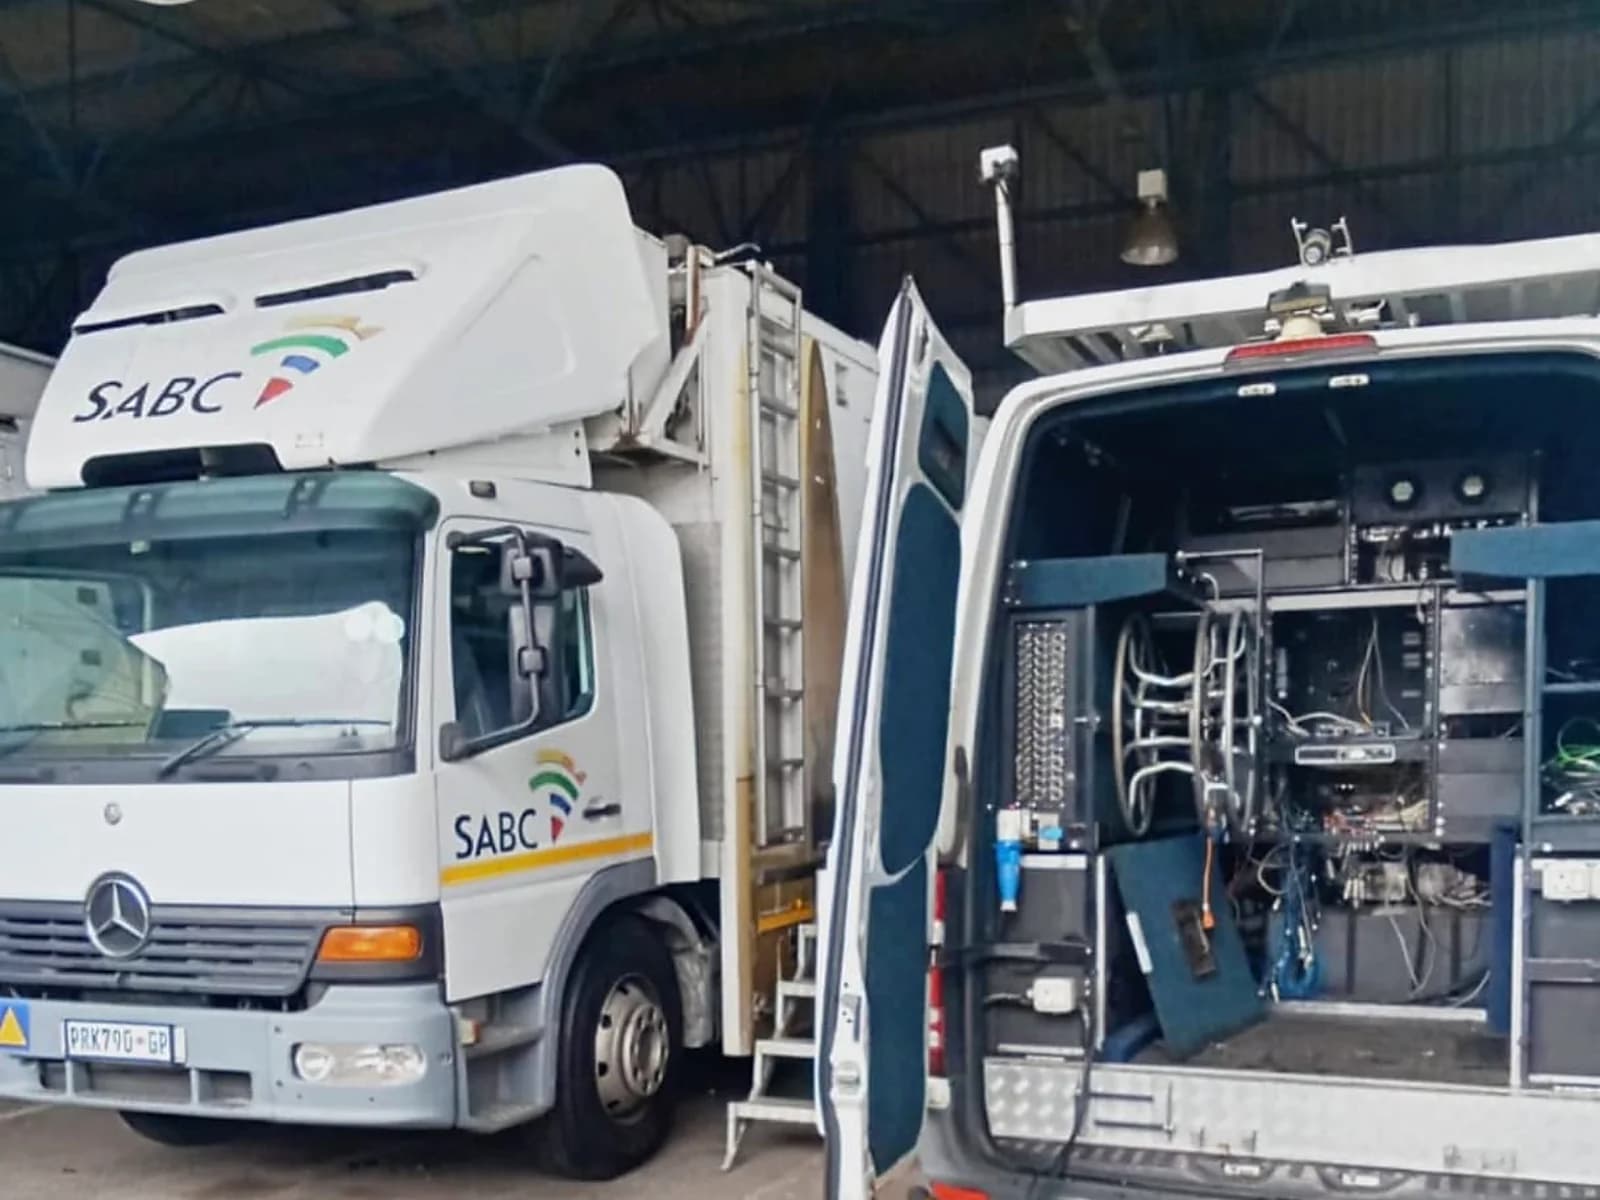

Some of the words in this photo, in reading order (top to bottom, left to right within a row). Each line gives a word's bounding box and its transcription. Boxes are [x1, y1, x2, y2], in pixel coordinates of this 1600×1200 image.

[73, 372, 242, 422] SABC
[455, 809, 538, 859] SABC
[148, 1031, 168, 1054] GP
